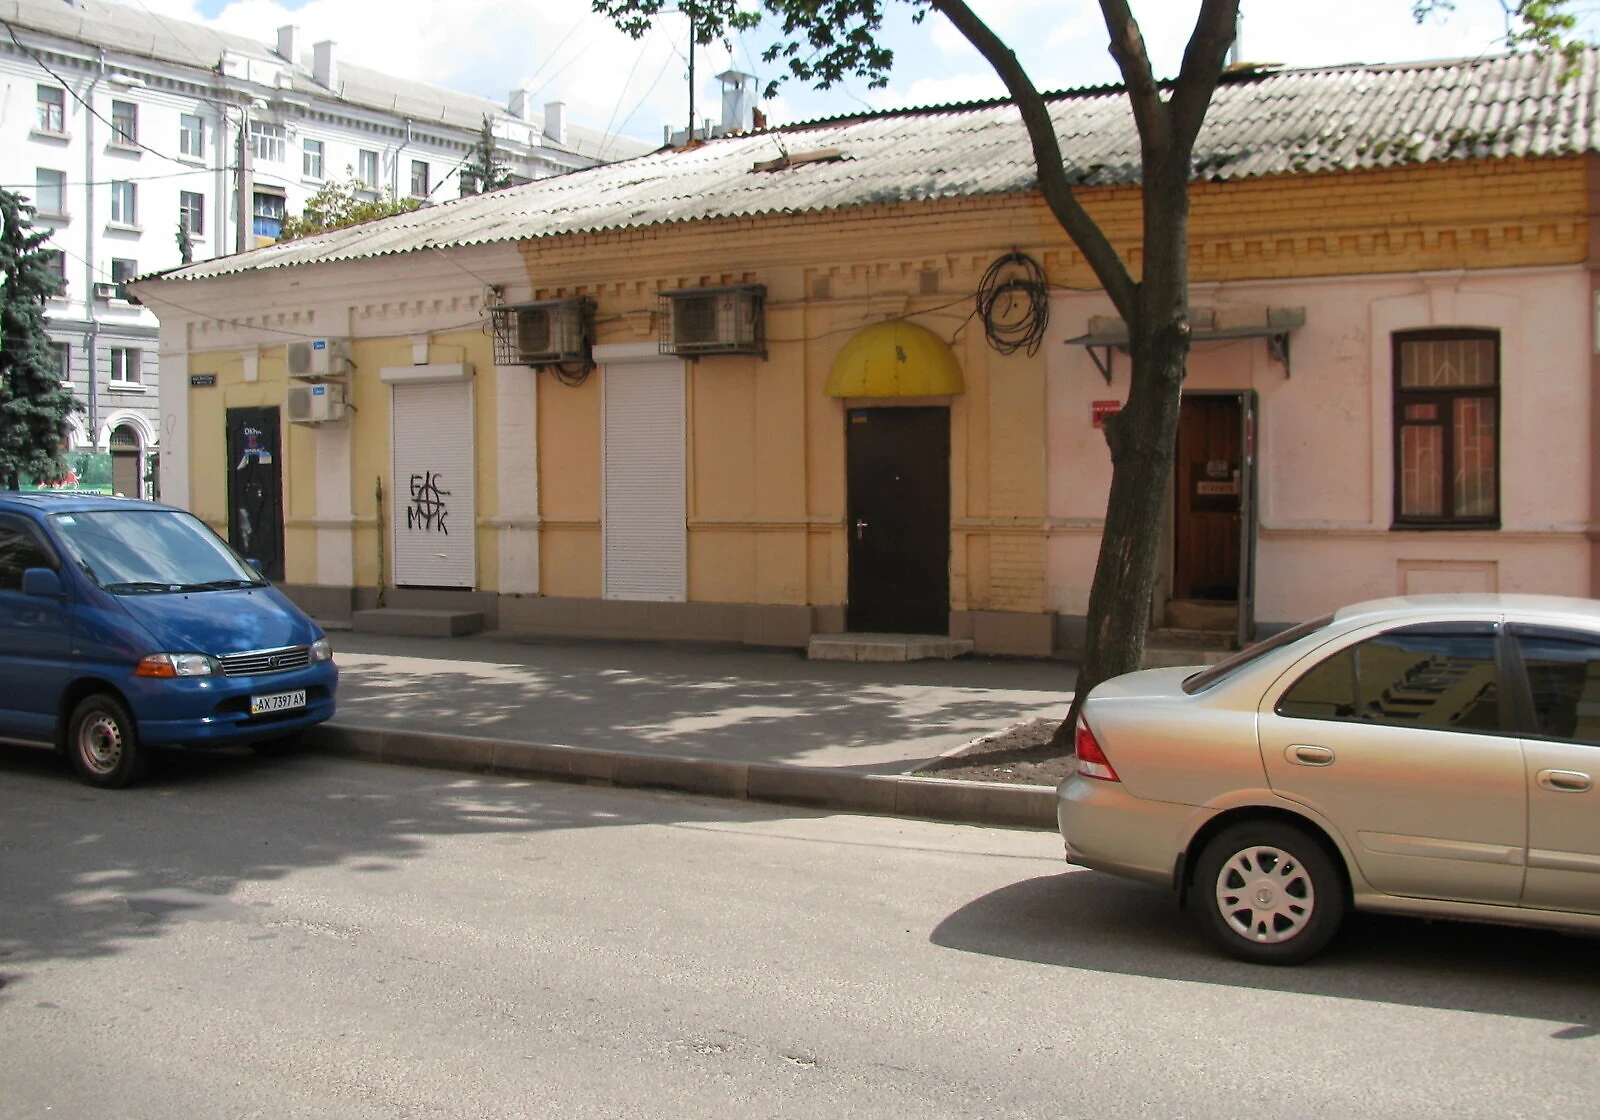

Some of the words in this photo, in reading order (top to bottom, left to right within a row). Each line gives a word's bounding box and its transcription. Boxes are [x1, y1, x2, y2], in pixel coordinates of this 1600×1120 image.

[258, 698, 270, 710] AX
[273, 695, 292, 709] 7397
[293, 692, 304, 705] AX
